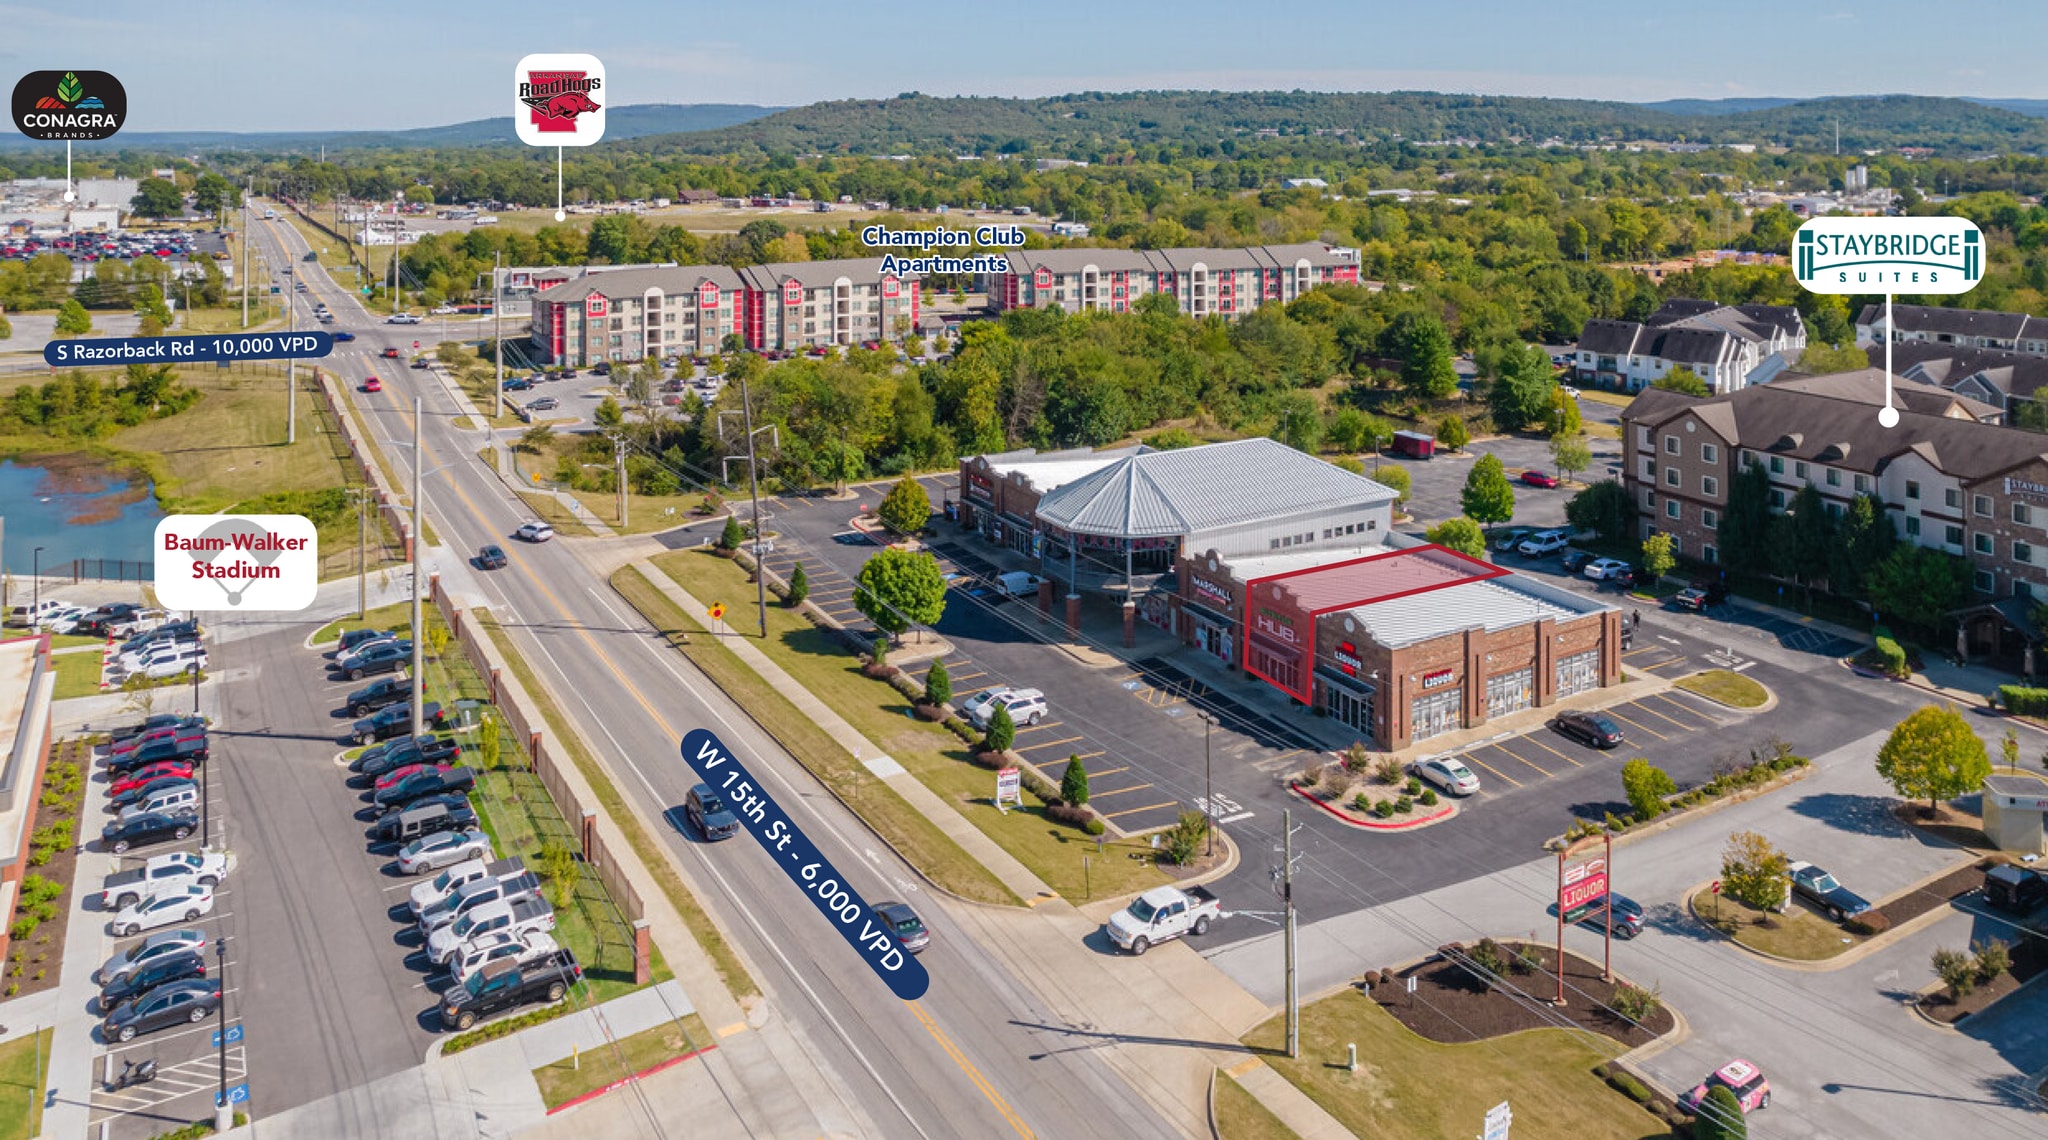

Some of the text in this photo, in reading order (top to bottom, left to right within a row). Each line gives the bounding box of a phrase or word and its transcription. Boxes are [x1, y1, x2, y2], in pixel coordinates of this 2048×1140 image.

[1191, 574, 1231, 602] MARSHALL
[1258, 614, 1294, 643] HUB
[1563, 878, 1605, 907] LIQUOR
